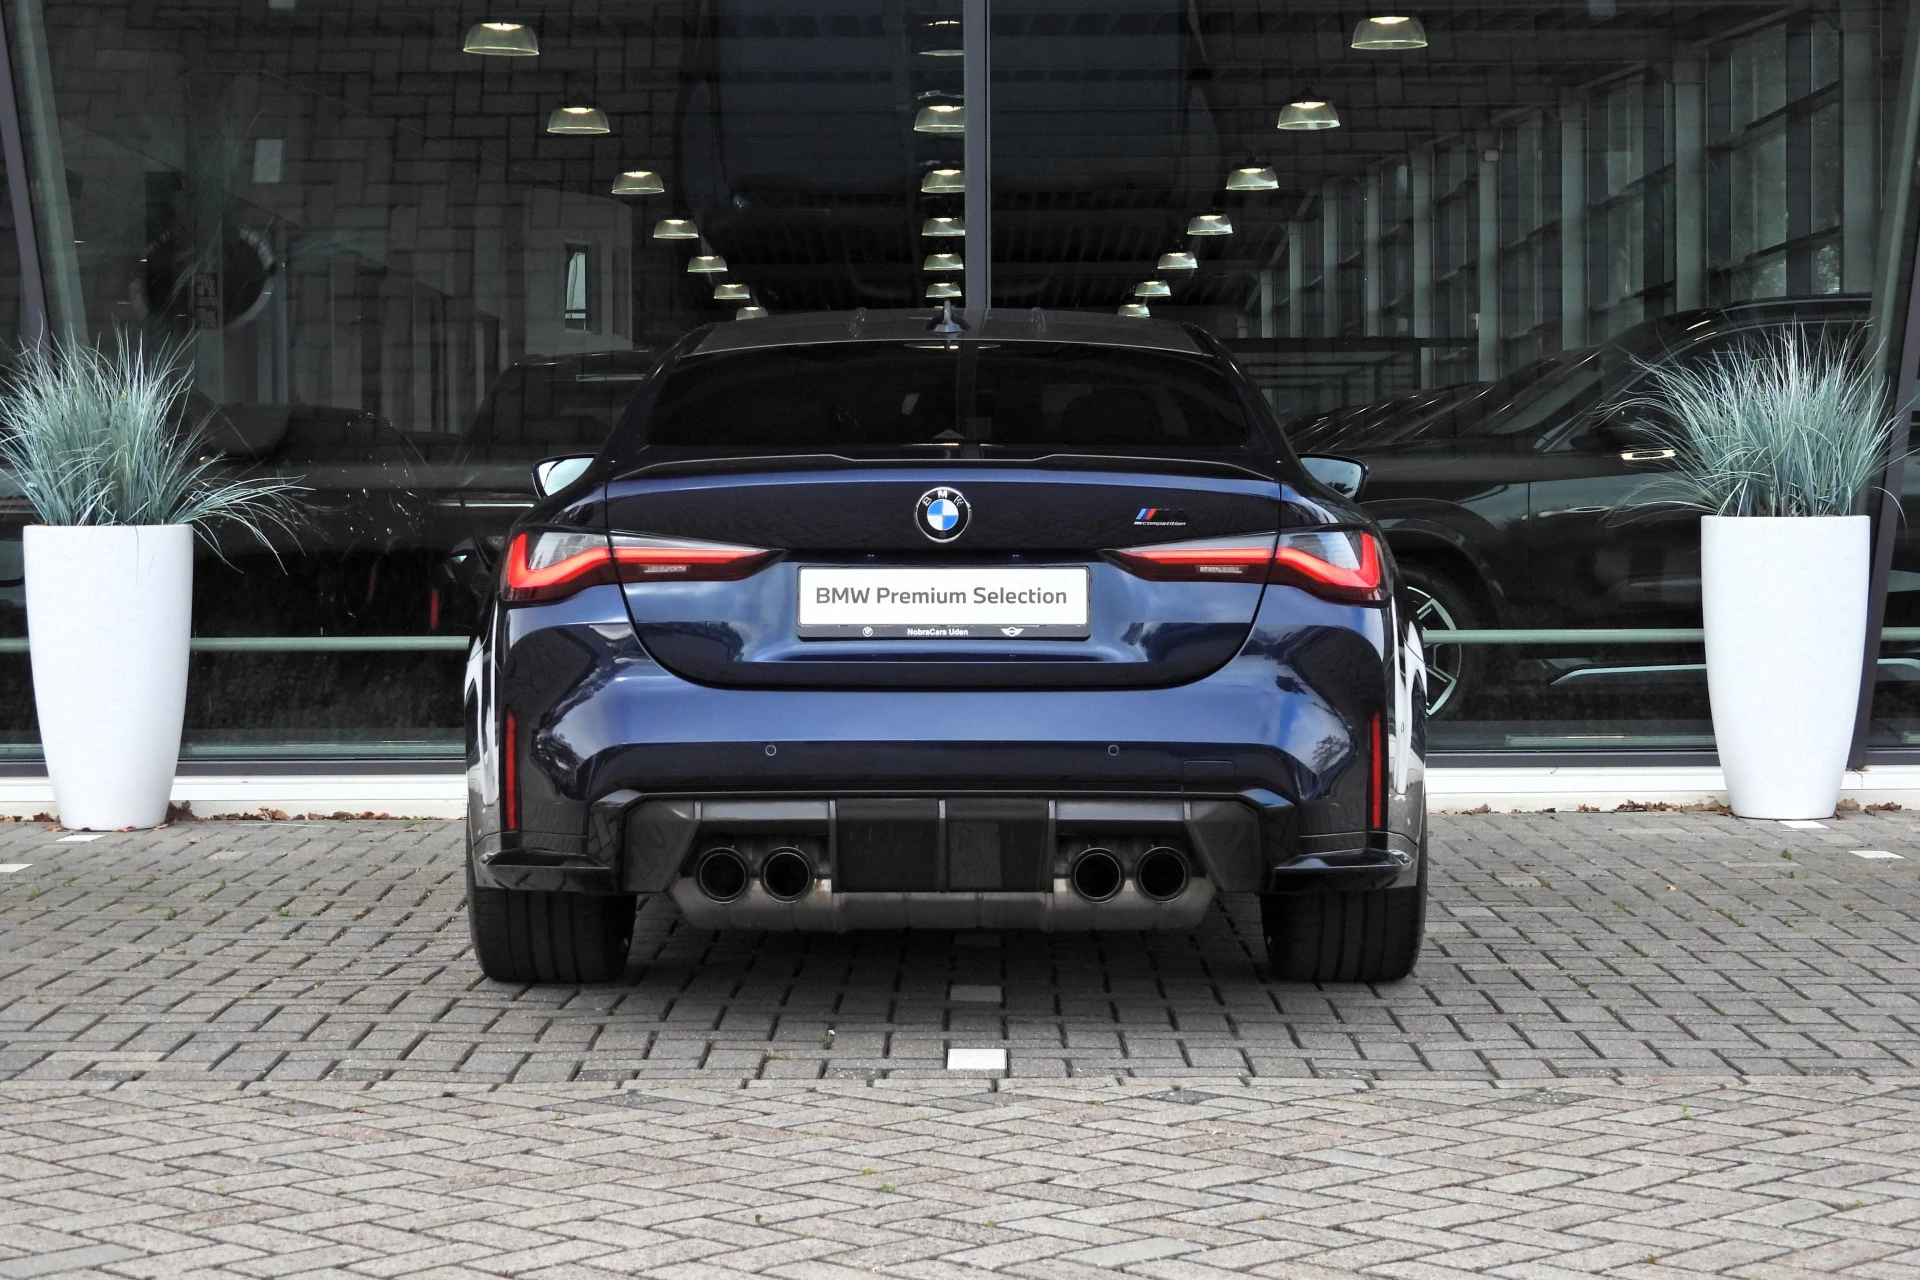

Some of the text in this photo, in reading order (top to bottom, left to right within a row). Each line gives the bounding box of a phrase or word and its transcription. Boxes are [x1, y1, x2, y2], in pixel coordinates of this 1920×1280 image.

[921, 489, 965, 507] BMW
[816, 586, 1067, 604] BMW Premium Selection
[907, 627, 969, 636] NobraCars Uden
